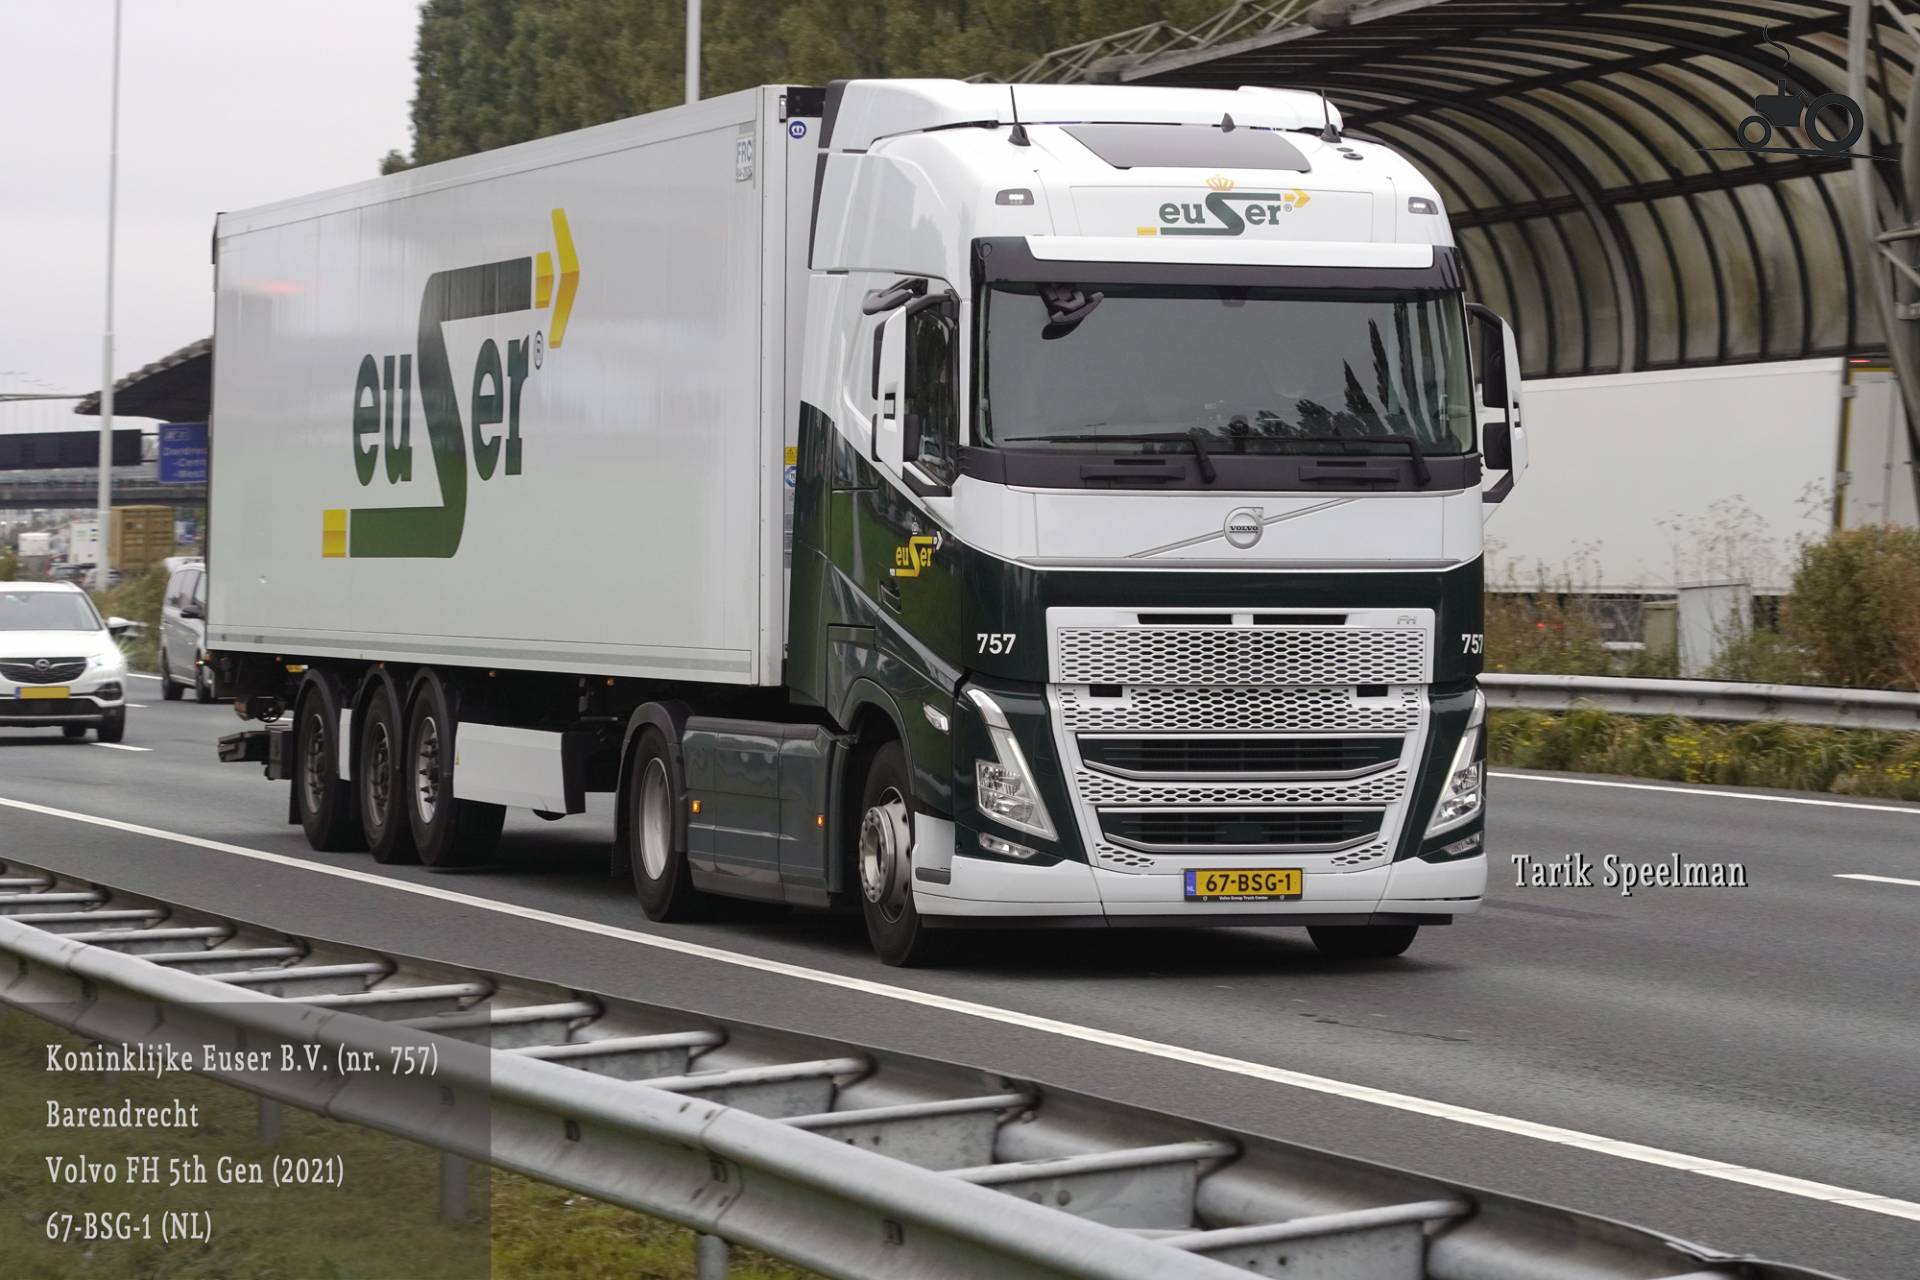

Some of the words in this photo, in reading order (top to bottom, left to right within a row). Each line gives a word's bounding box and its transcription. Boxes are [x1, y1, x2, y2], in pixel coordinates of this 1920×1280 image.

[736, 139, 752, 164] FRC
[976, 633, 1017, 655] 757
[1461, 633, 1484, 654] 757
[1205, 873, 1291, 892] 67-BSG-1
